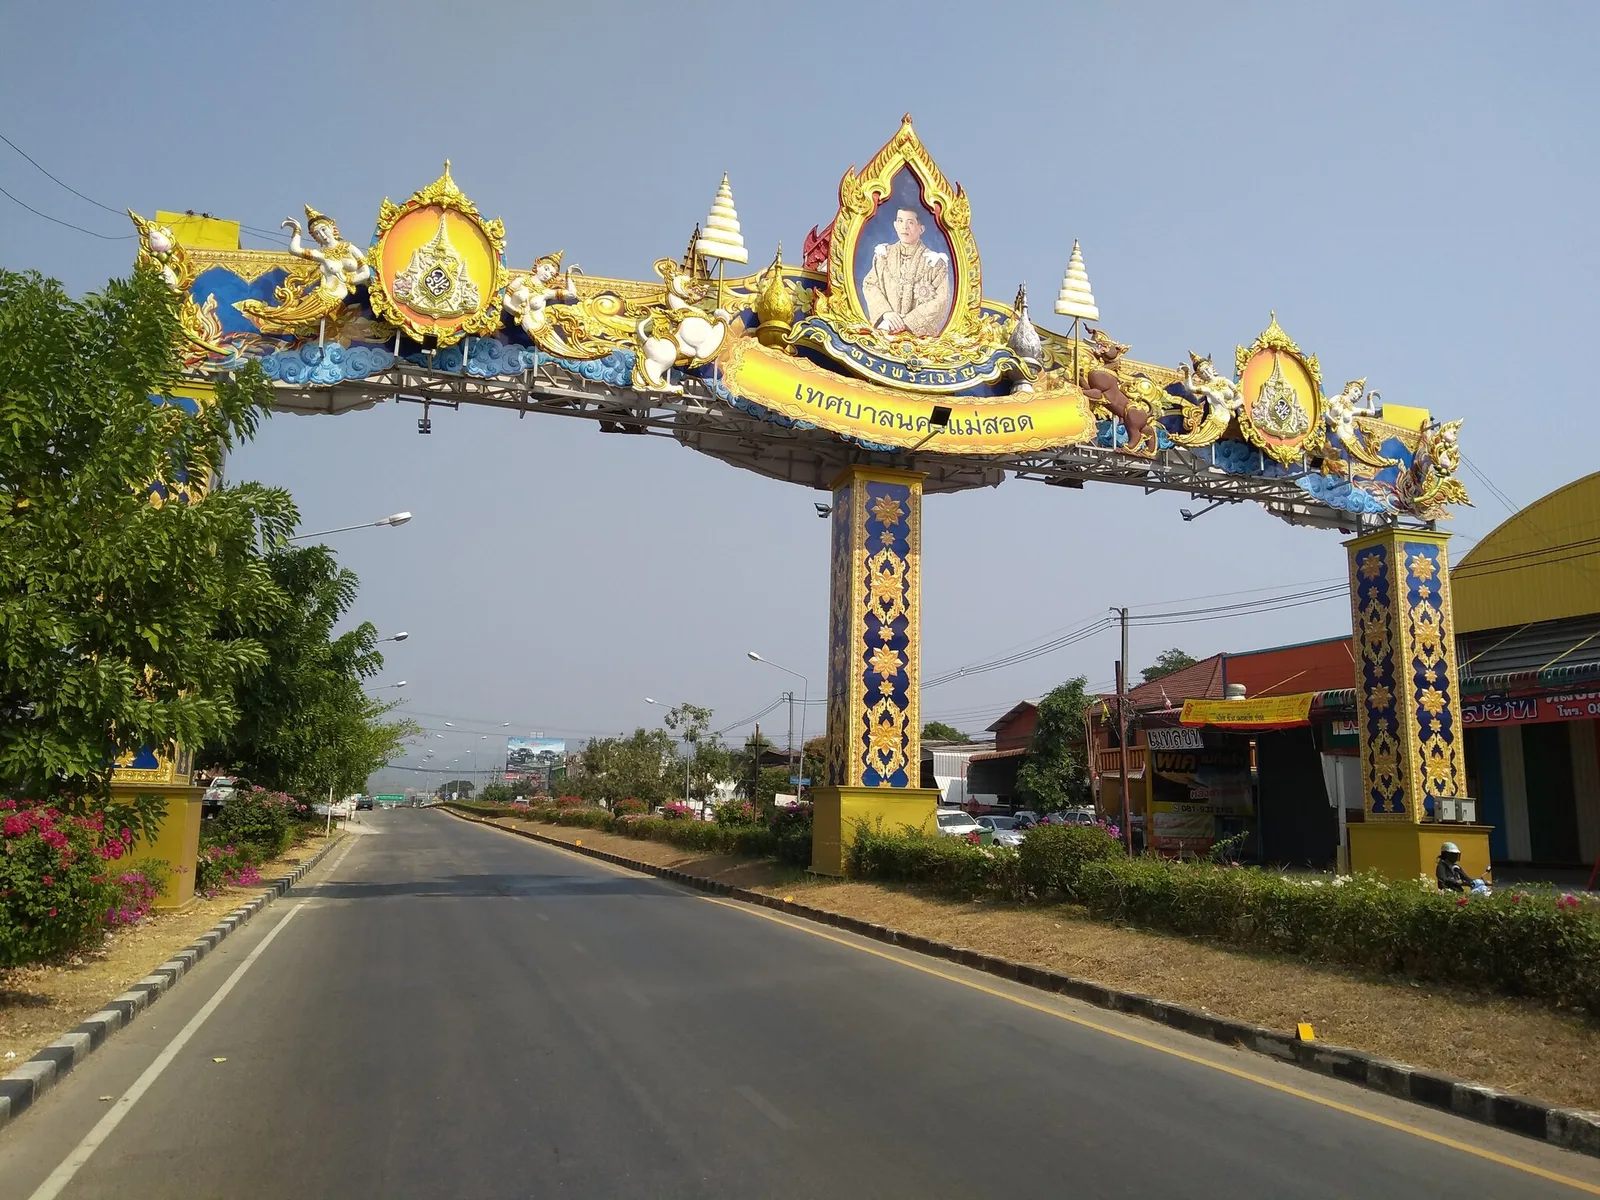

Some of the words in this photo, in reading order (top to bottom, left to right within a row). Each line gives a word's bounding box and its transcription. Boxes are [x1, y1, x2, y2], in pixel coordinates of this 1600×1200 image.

[851, 347, 976, 383] ทรงพระเจริญ
[795, 383, 1034, 436] เทศบาลนคแม่สอด
